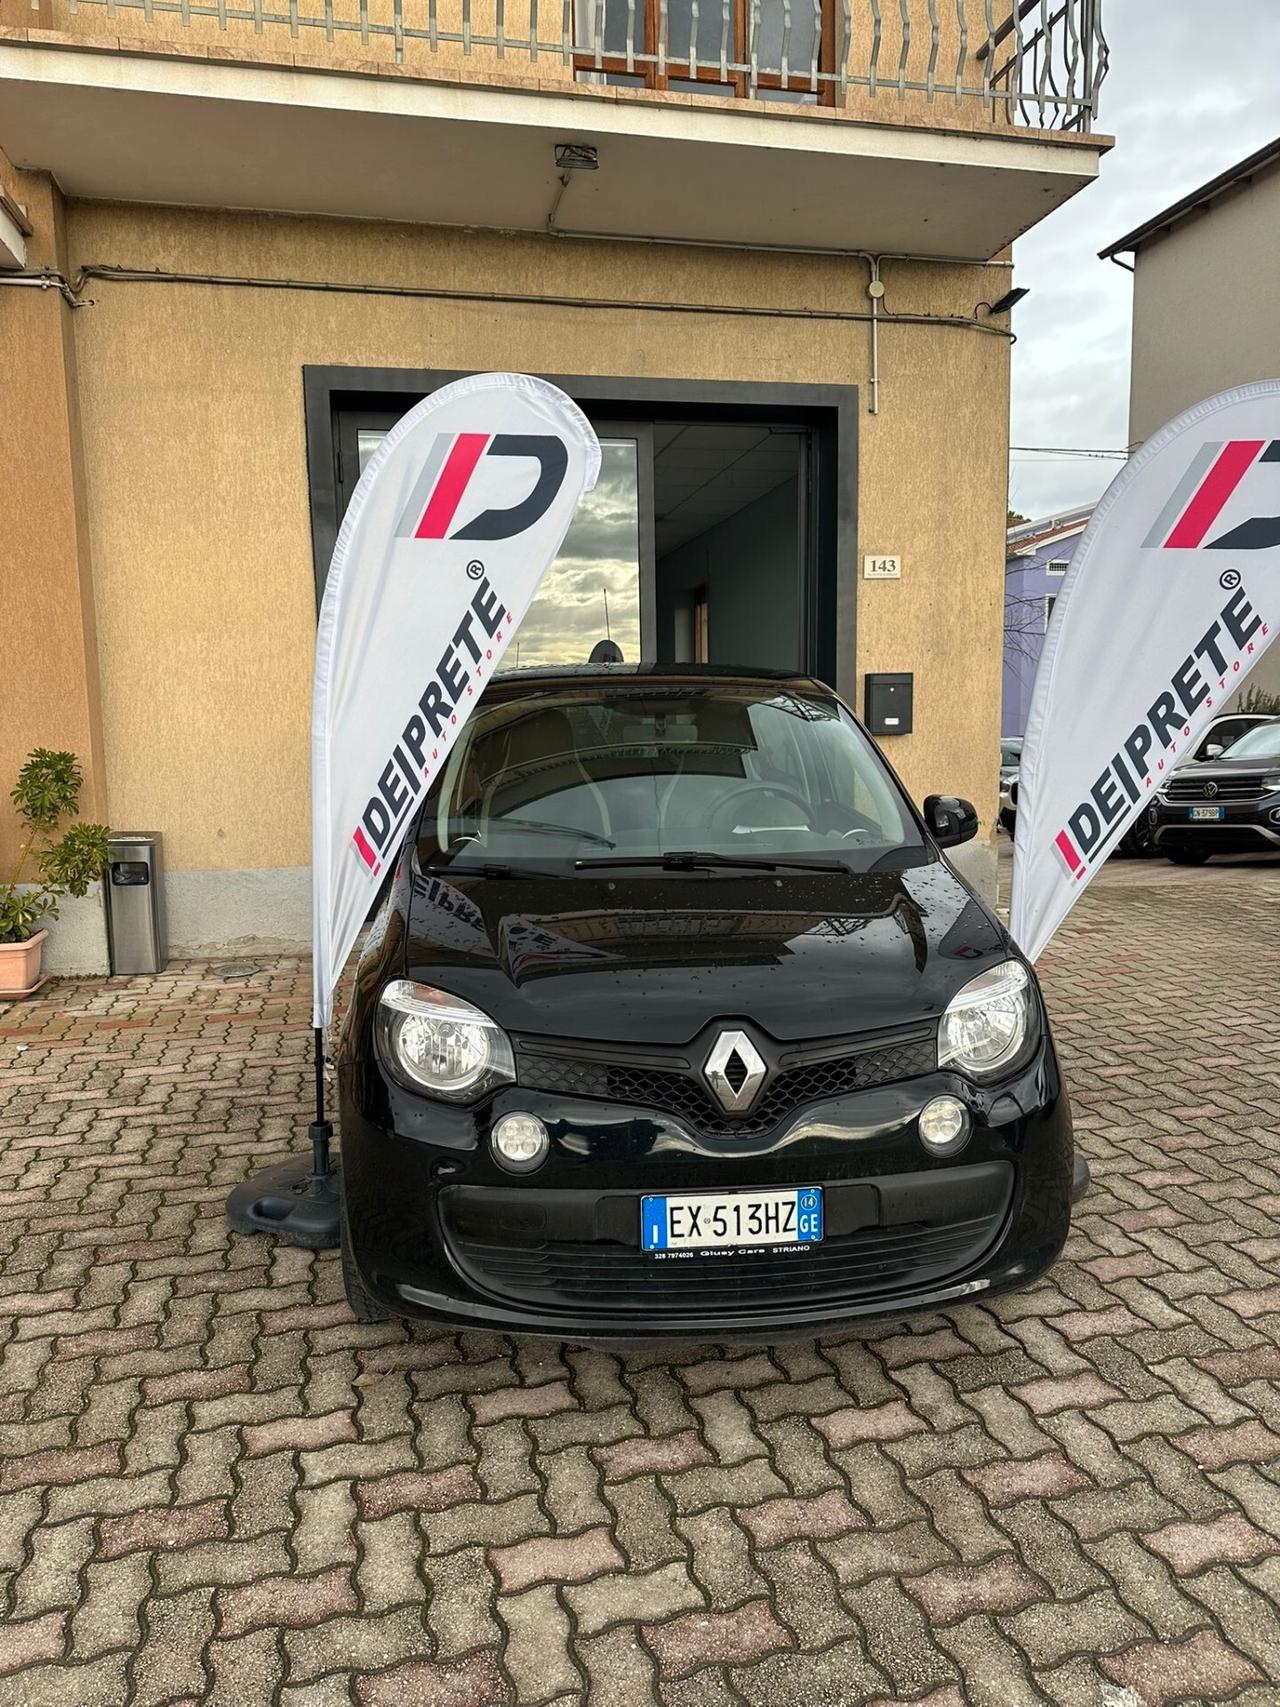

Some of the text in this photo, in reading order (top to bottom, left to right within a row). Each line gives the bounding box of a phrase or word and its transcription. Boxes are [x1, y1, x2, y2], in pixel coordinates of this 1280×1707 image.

[871, 559, 896, 572] 143
[423, 611, 513, 778] AUTO STORE
[1145, 622, 1269, 788] AUTO STORE
[803, 1197, 814, 1207] 14
[800, 1214, 818, 1233] GE
